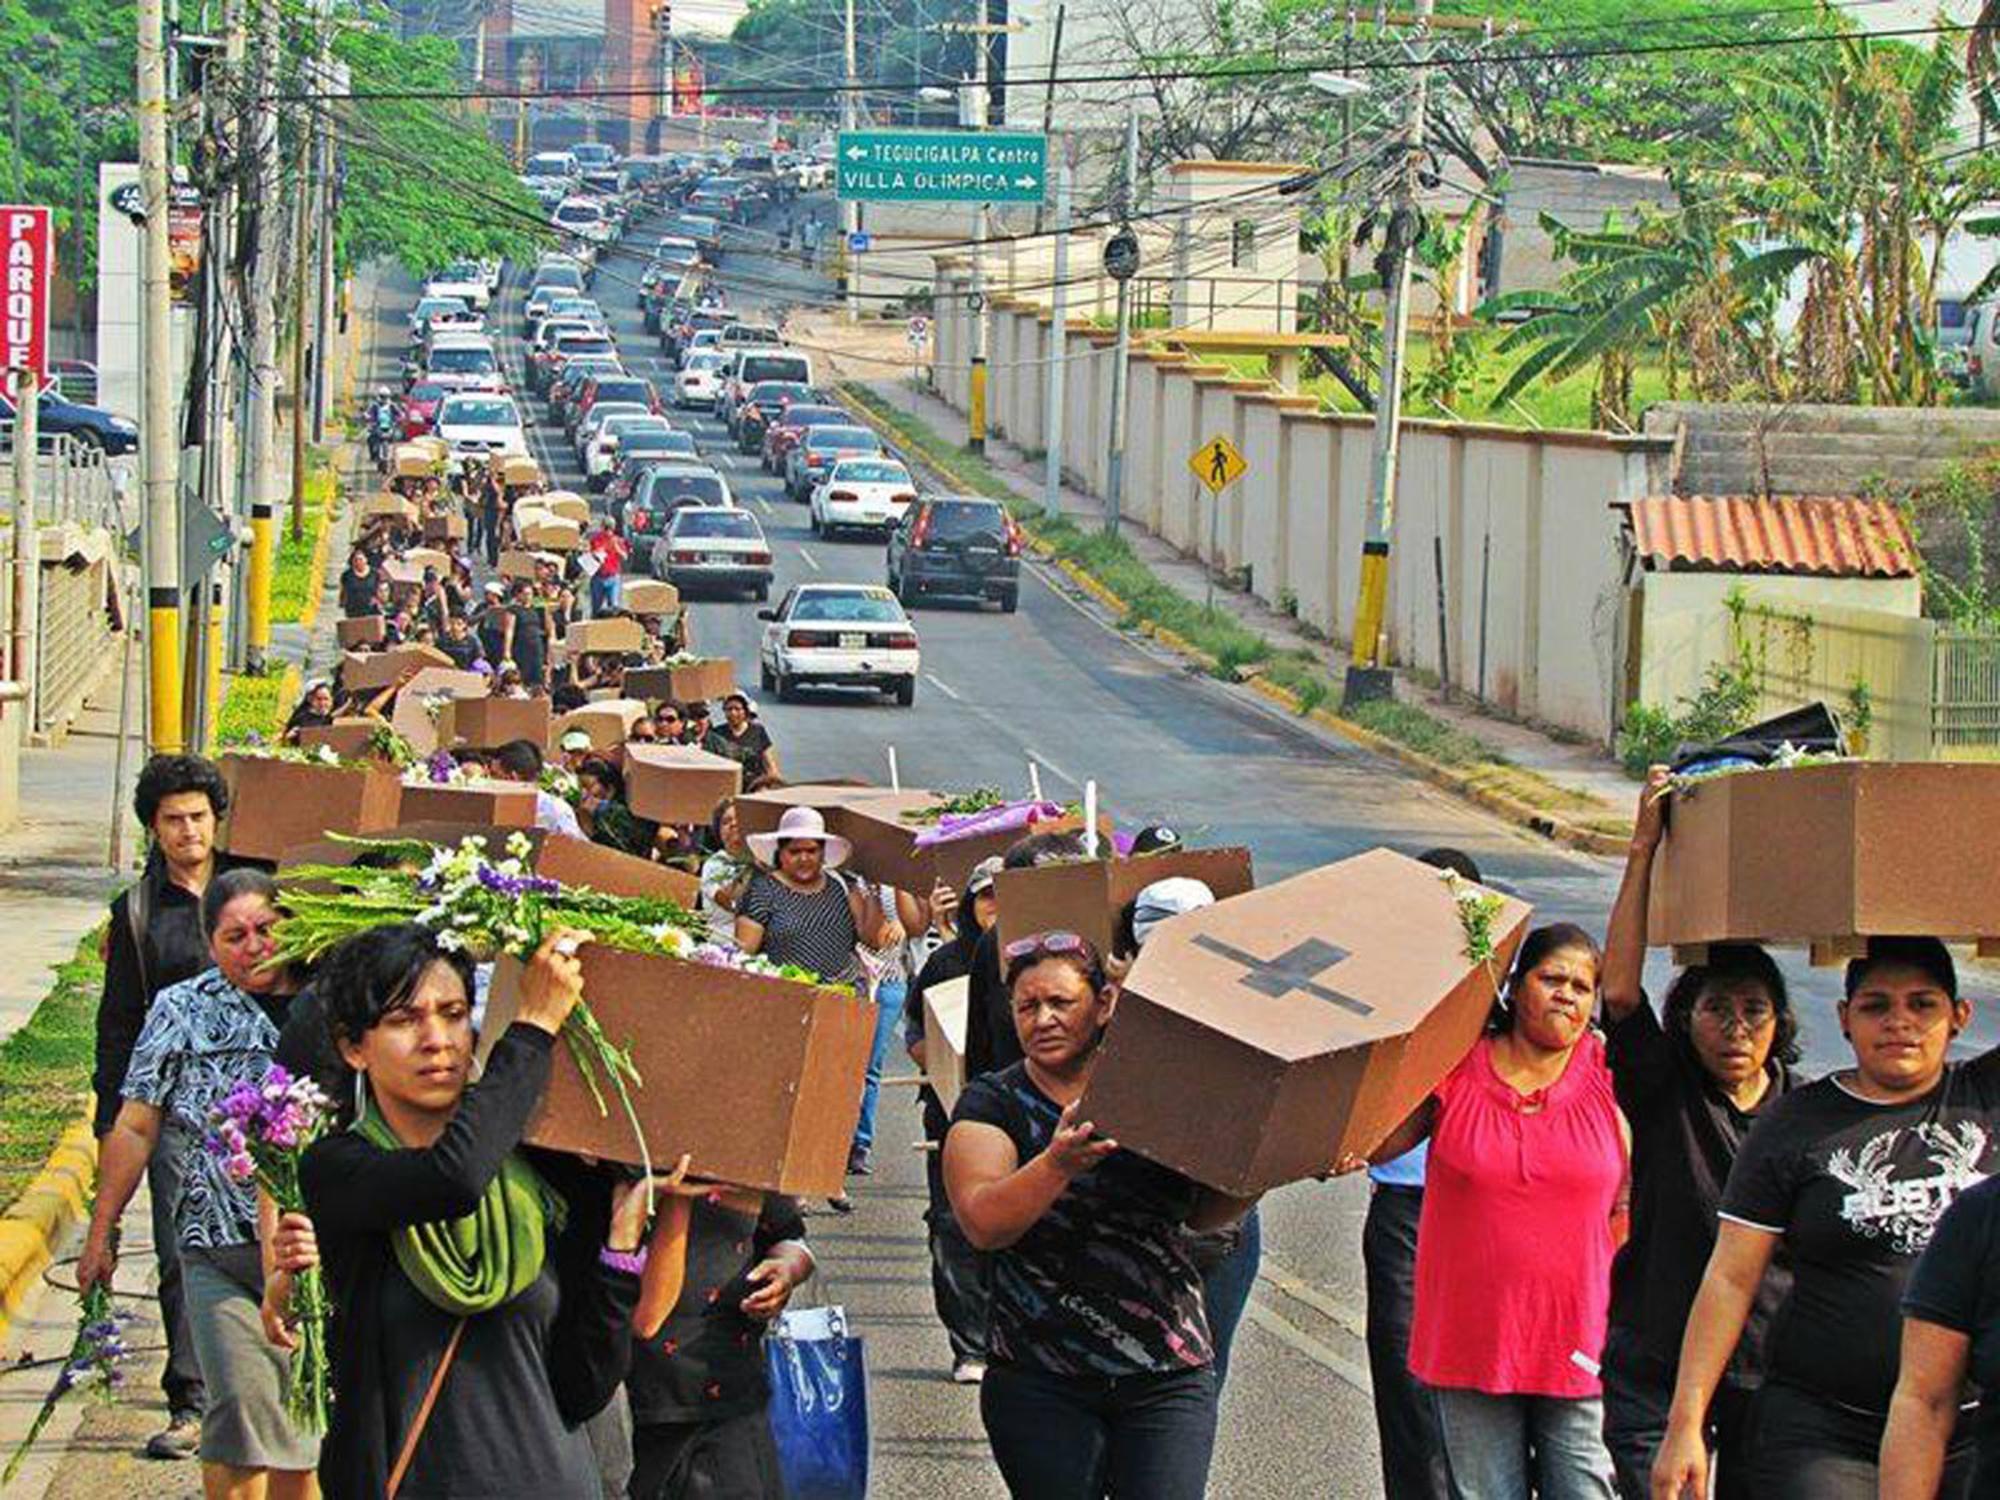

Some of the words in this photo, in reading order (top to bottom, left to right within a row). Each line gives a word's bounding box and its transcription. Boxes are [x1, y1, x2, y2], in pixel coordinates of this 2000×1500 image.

[874, 144, 980, 163] TEGUCIGALPA
[987, 148, 1039, 164] Centro
[845, 172, 905, 189] VILLA
[914, 173, 1008, 191] OLIMPICA
